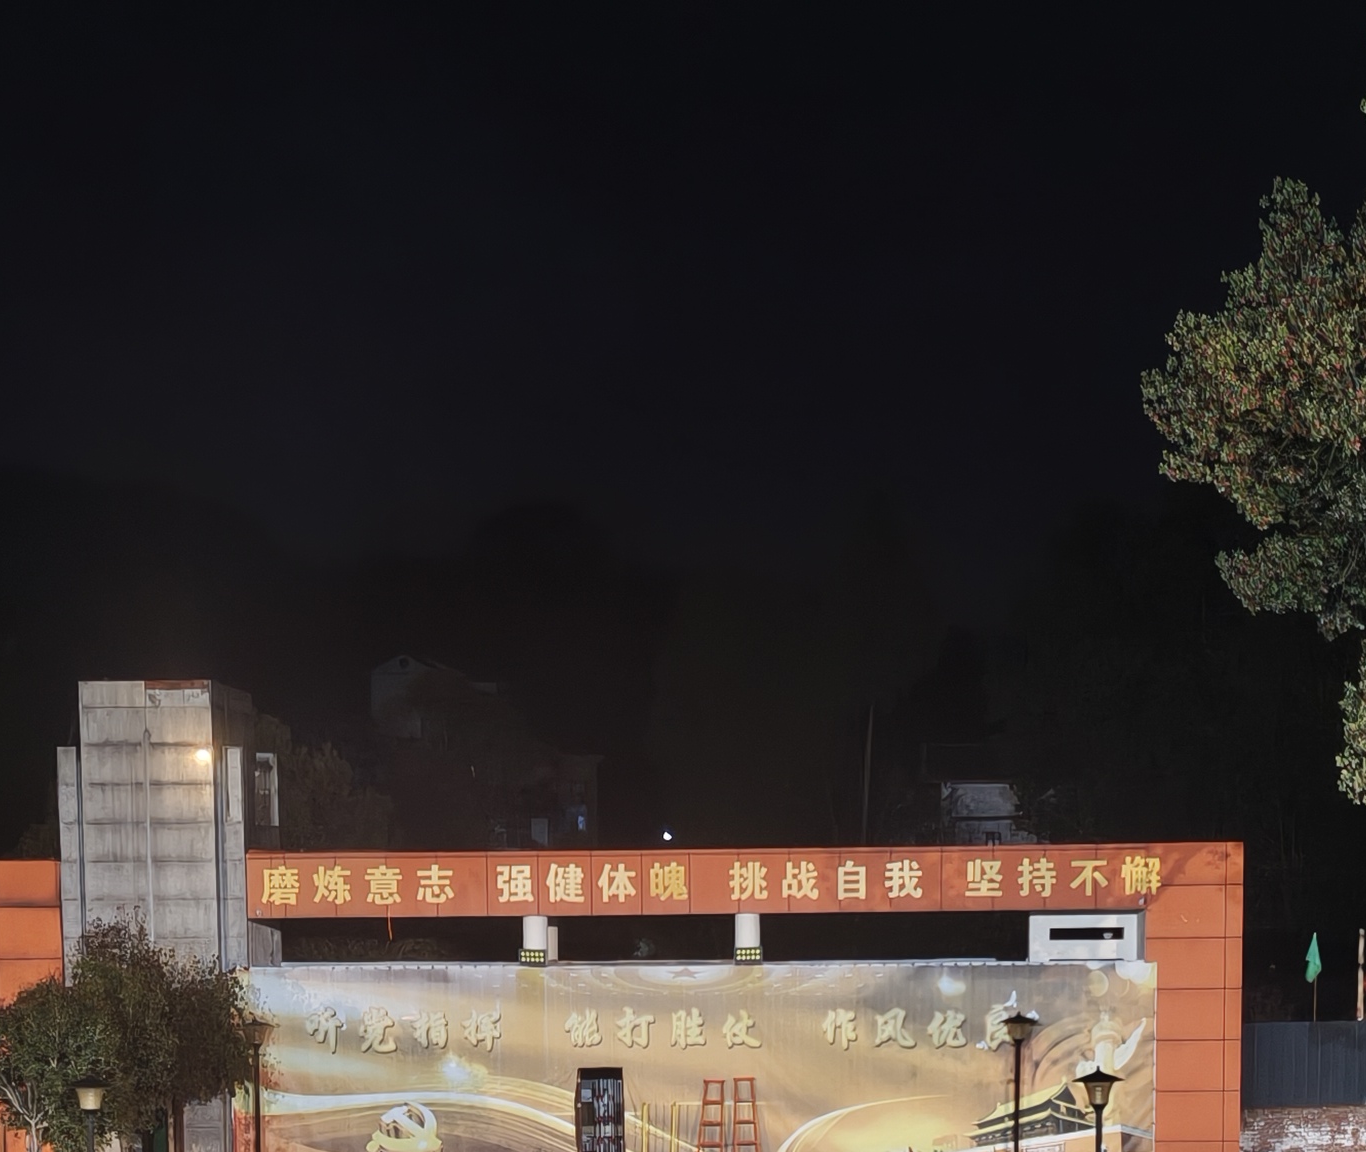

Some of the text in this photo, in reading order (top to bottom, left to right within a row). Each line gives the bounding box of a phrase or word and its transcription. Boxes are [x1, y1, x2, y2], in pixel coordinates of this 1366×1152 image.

[261, 855, 1162, 906] 磨炼意志 强健体魄 挑战自我 坚持不懈
[305, 1005, 502, 1055] 听党指挥
[563, 1006, 762, 1051] 能打胜仗
